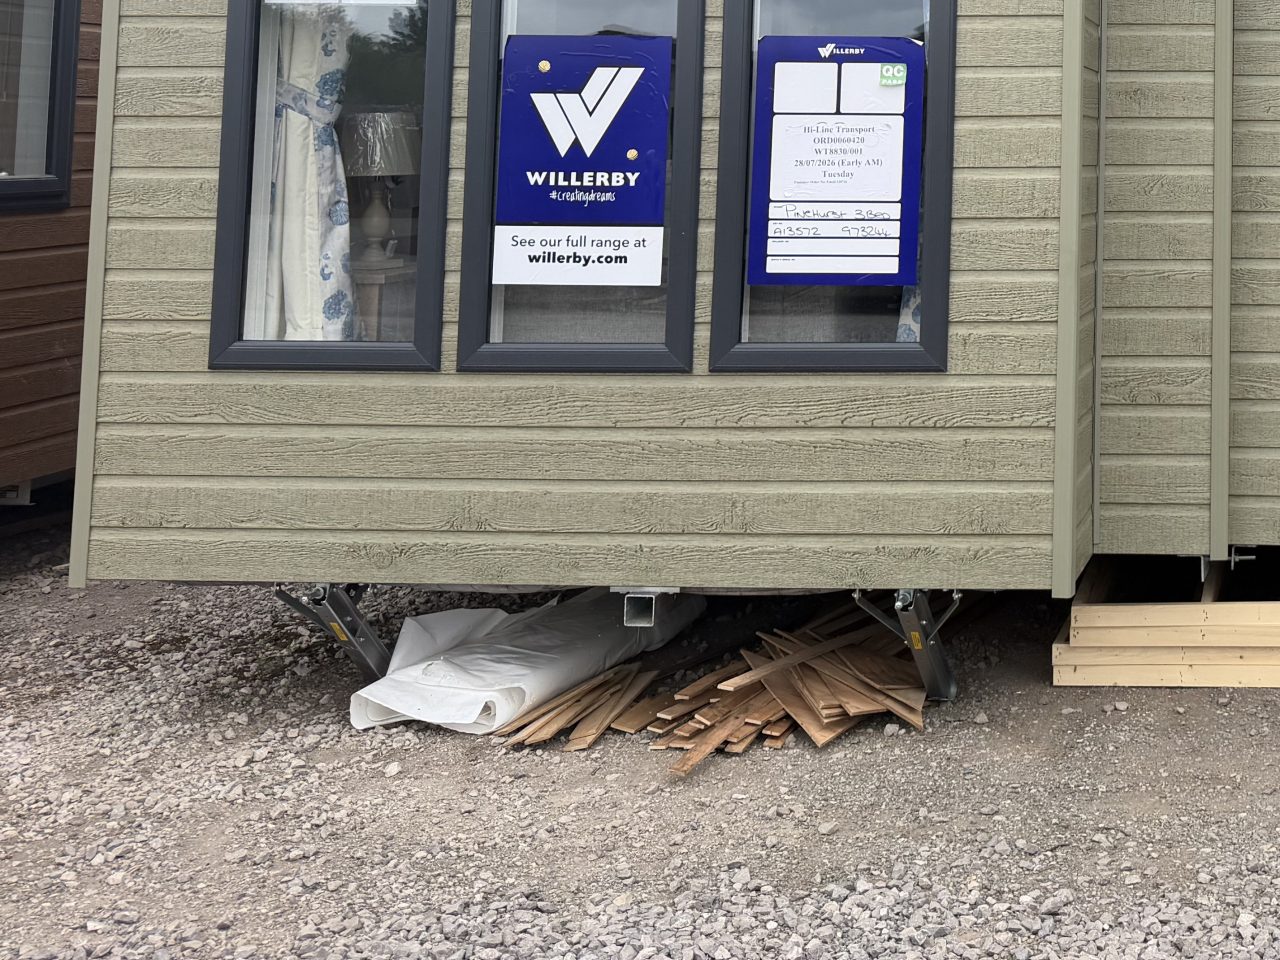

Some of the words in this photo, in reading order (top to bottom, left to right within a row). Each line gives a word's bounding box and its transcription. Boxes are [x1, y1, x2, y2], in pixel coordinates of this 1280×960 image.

[882, 65, 904, 77] QC
[836, 126, 875, 135] Transport
[794, 159, 836, 167] 28/07/2026
[838, 159, 862, 168] (Early
[864, 159, 883, 167] AM)
[526, 172, 640, 186] WILLERBY
[822, 171, 855, 179] Tuesday
[549, 189, 616, 207] #creatingdreams
[511, 235, 536, 247] See
[540, 238, 562, 247] our
[566, 235, 587, 247] full
[591, 239, 629, 250] range
[634, 238, 646, 248] at
[528, 252, 628, 267] willerby.com
